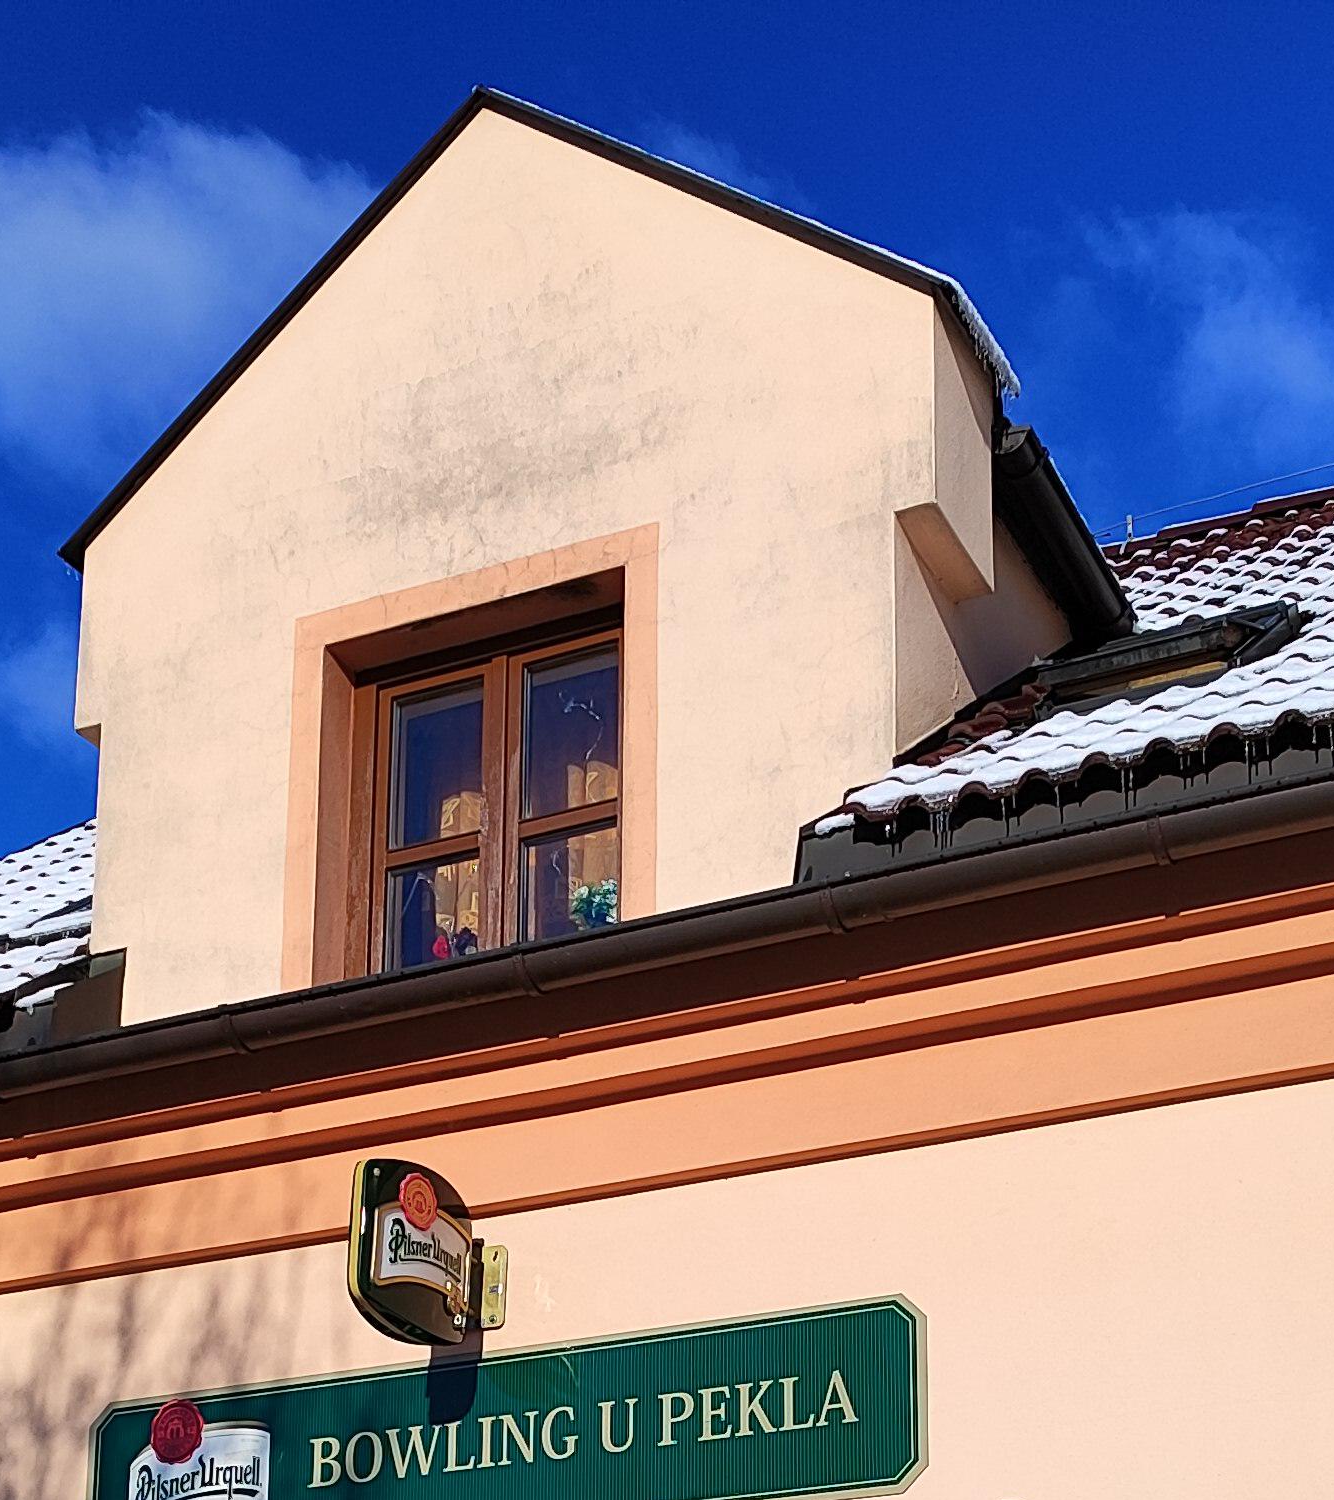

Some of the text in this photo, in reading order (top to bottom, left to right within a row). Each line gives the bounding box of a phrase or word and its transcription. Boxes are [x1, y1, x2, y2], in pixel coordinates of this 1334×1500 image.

[388, 1217, 462, 1277] Pilsner Urquell
[306, 1368, 860, 1490] BOWLING U PEKLA
[198, 1454, 261, 1500] Urquell
